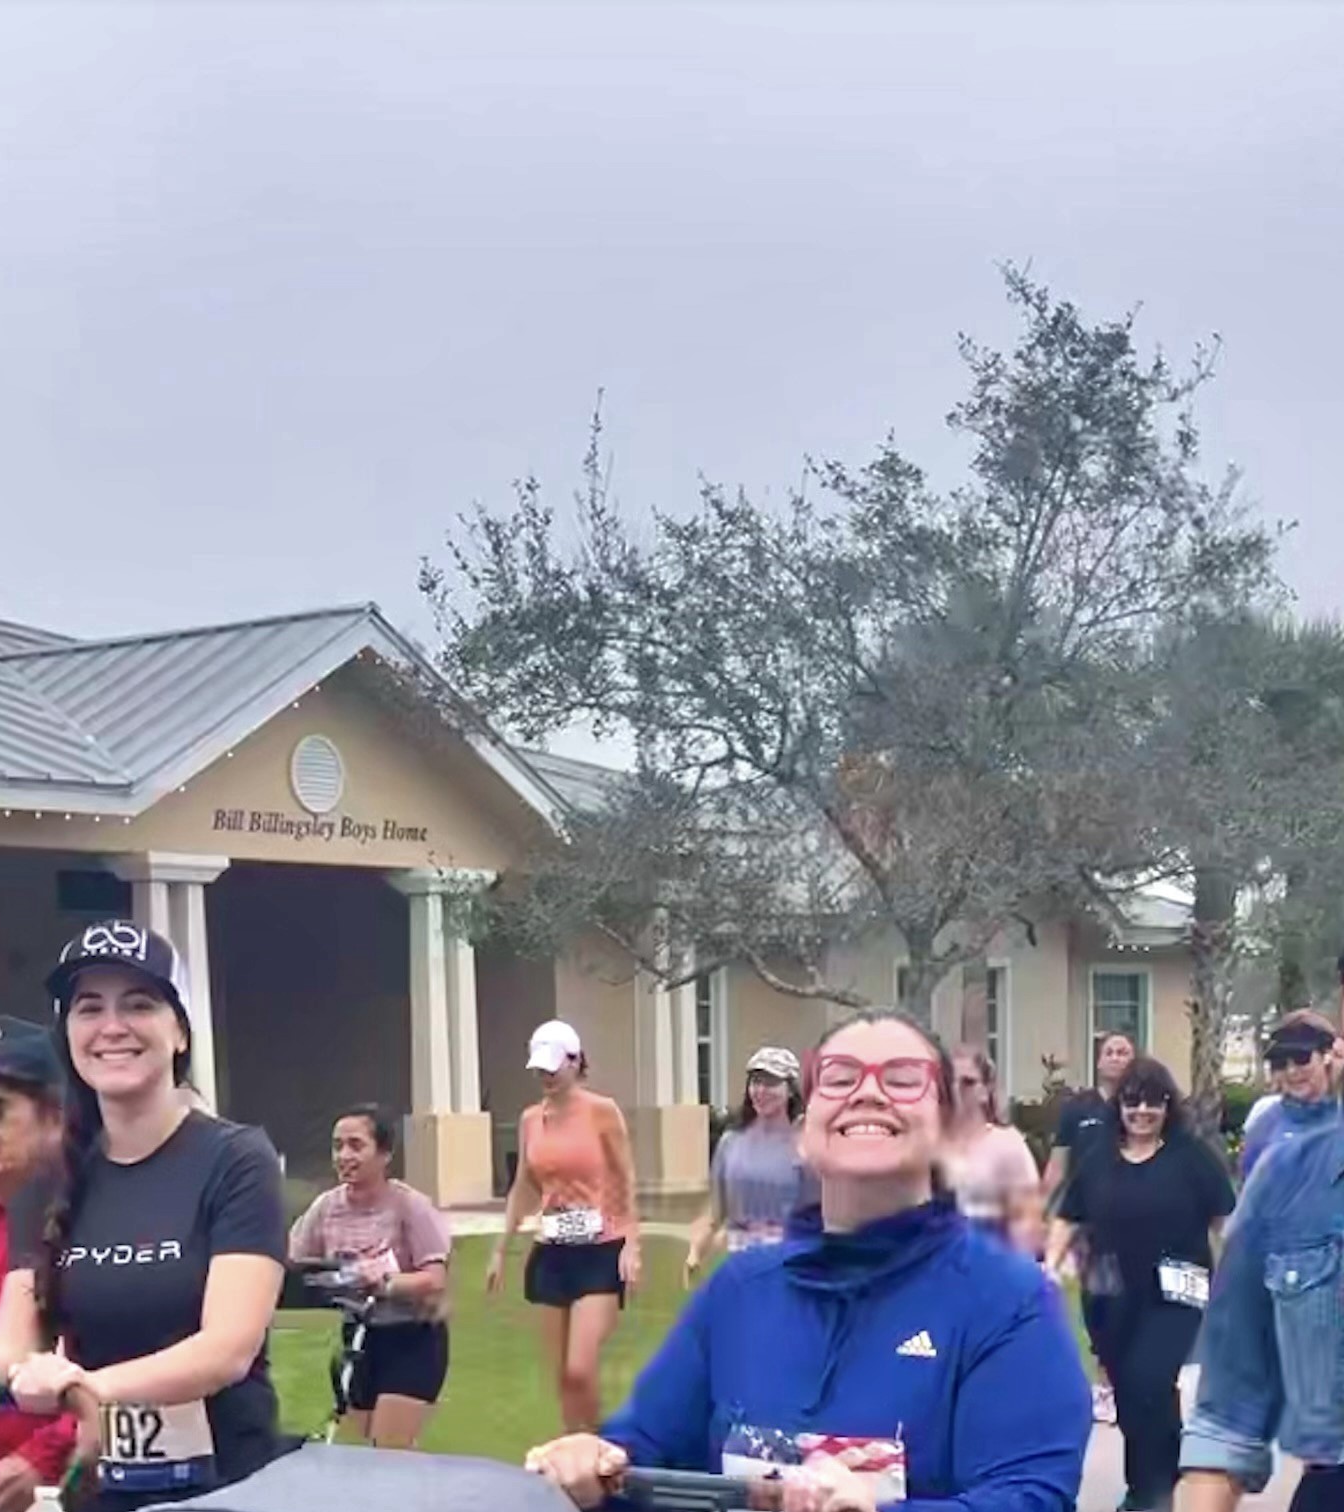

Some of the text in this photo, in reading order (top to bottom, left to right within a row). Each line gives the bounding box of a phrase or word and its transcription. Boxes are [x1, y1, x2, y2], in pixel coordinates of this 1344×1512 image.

[212, 808, 428, 844] Bill Billingsley Boys Home
